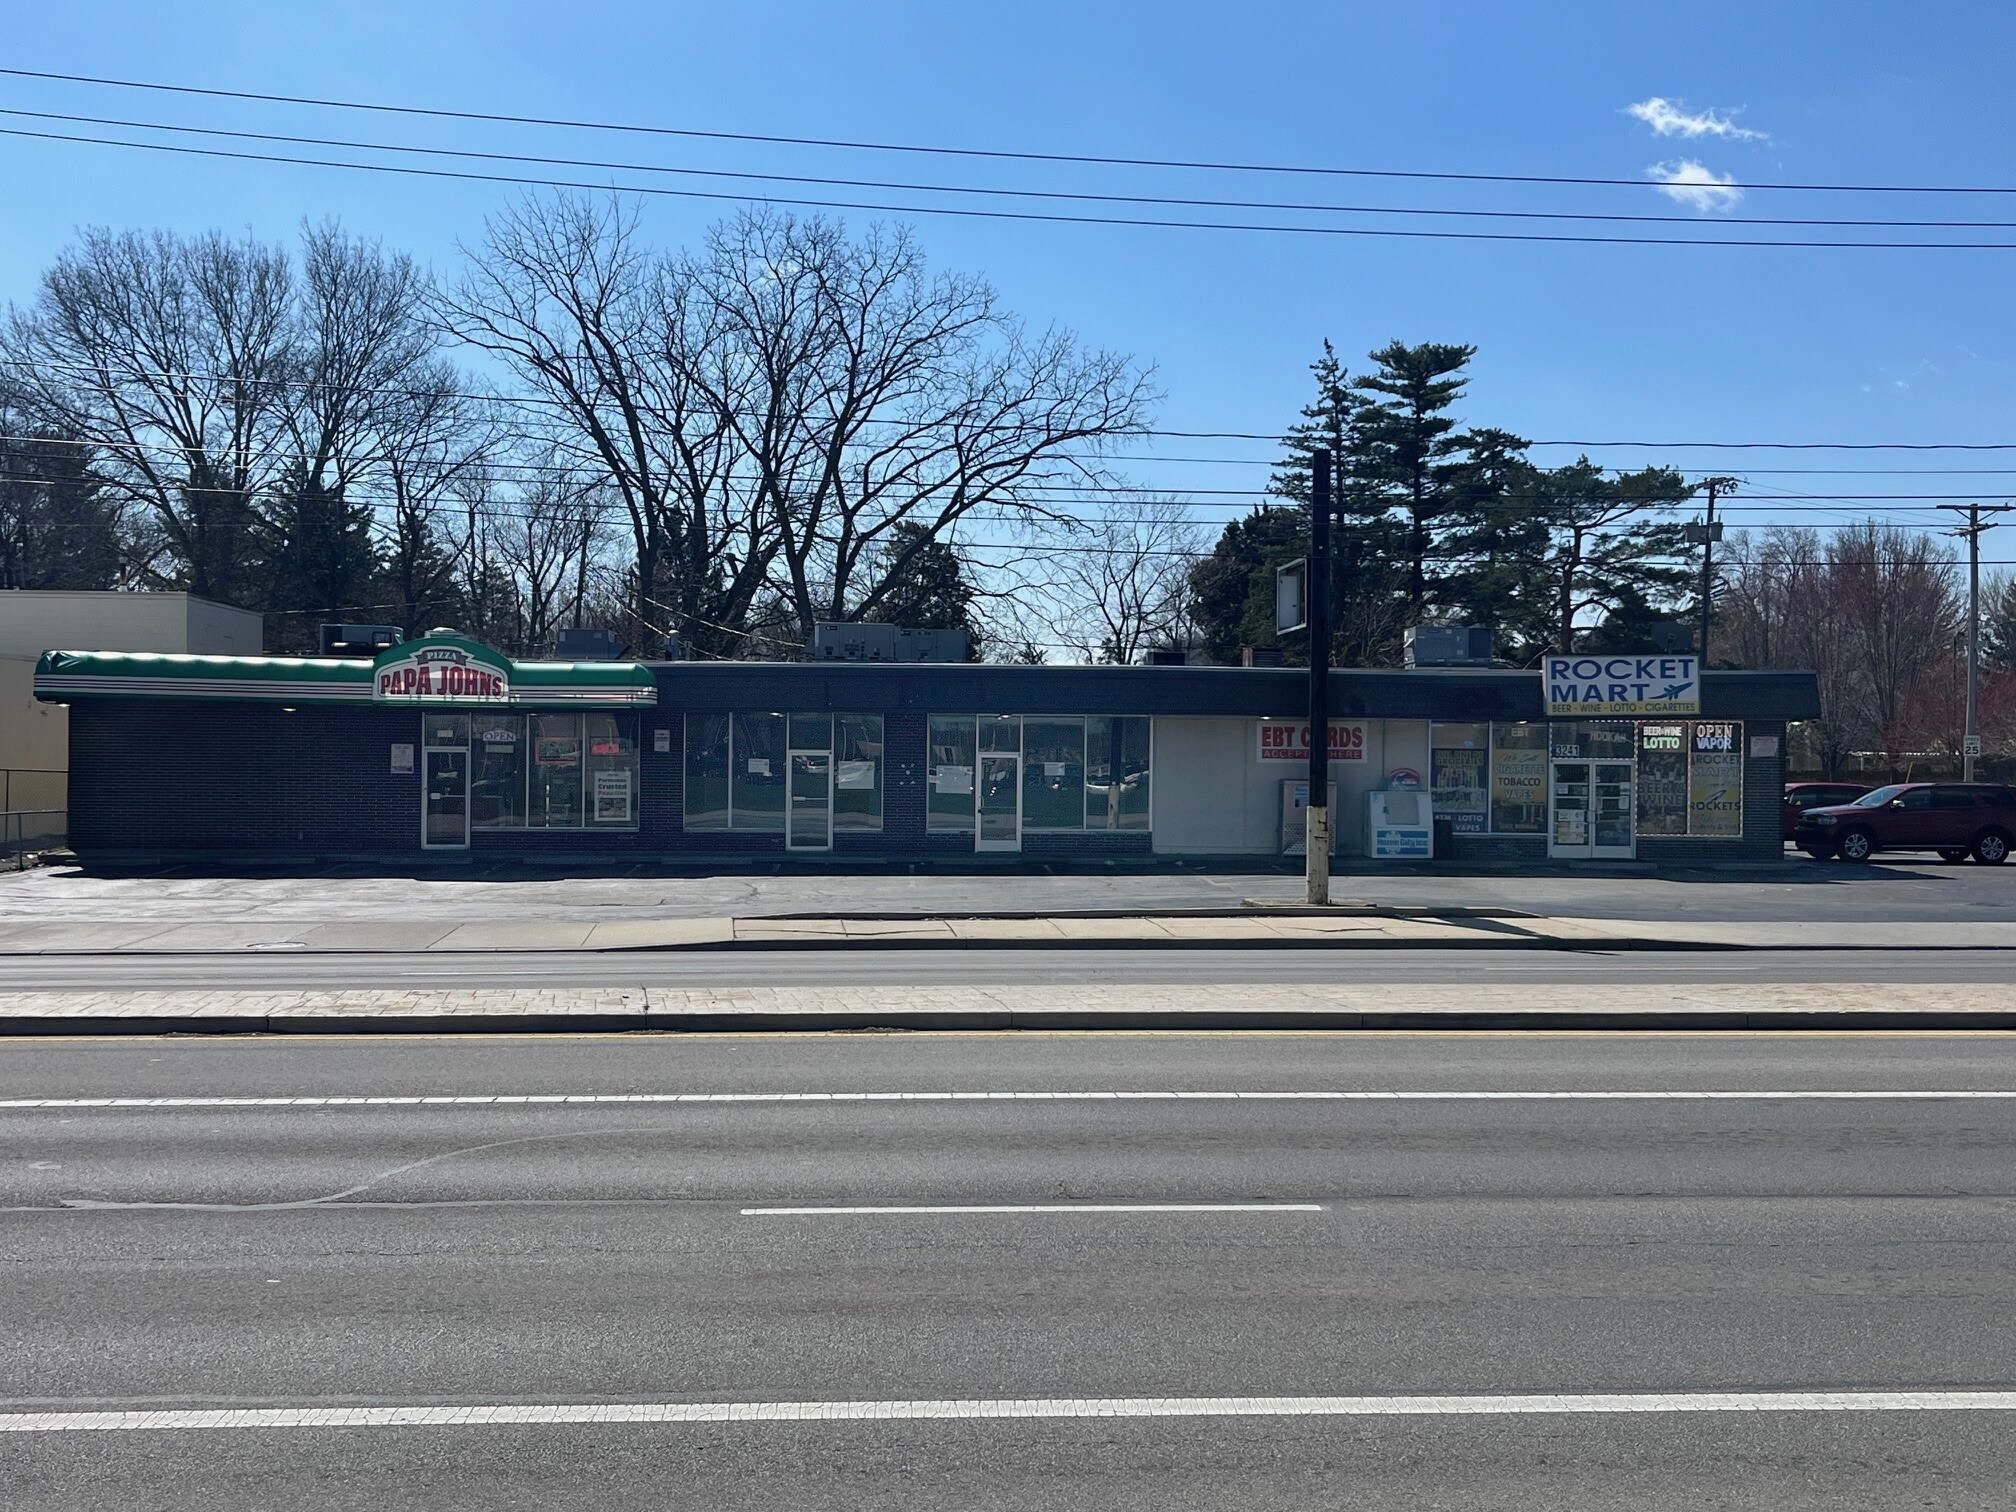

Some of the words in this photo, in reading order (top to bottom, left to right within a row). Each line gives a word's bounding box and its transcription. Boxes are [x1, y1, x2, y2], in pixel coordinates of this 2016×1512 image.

[427, 651, 457, 660] PIZZA
[1551, 659, 1694, 680] ROCKET
[381, 667, 431, 694] PAPA
[437, 666, 502, 695] JOHN'S
[1551, 683, 1650, 702] MART
[1552, 704, 1572, 713] BEER
[1580, 703, 1601, 712] WINE
[1610, 703, 1636, 712] LOTTO
[1645, 702, 1695, 712] CIGARETTES
[485, 732, 514, 740] OPEN
[1511, 728, 1530, 737] EBT
[1643, 726, 1661, 736] BEER
[1664, 726, 1682, 736] WINE
[1696, 725, 1733, 737] OPEN
[1262, 727, 1295, 747] EBT
[1301, 726, 1362, 748] CRDS
[1590, 731, 1626, 743] HOOKAH
[1643, 737, 1679, 749] LOTTO
[1696, 738, 1732, 749] VAPOR
[1330, 750, 1360, 758] HERE
[1556, 745, 1579, 756] 3241
[1965, 746, 1978, 754] 25
[1495, 764, 1544, 774] CIGARETTE
[1498, 777, 1541, 786] TOBACCO
[1639, 783, 1671, 793] BEER
[1505, 789, 1534, 799] VAPES
[1641, 795, 1683, 805] WINE
